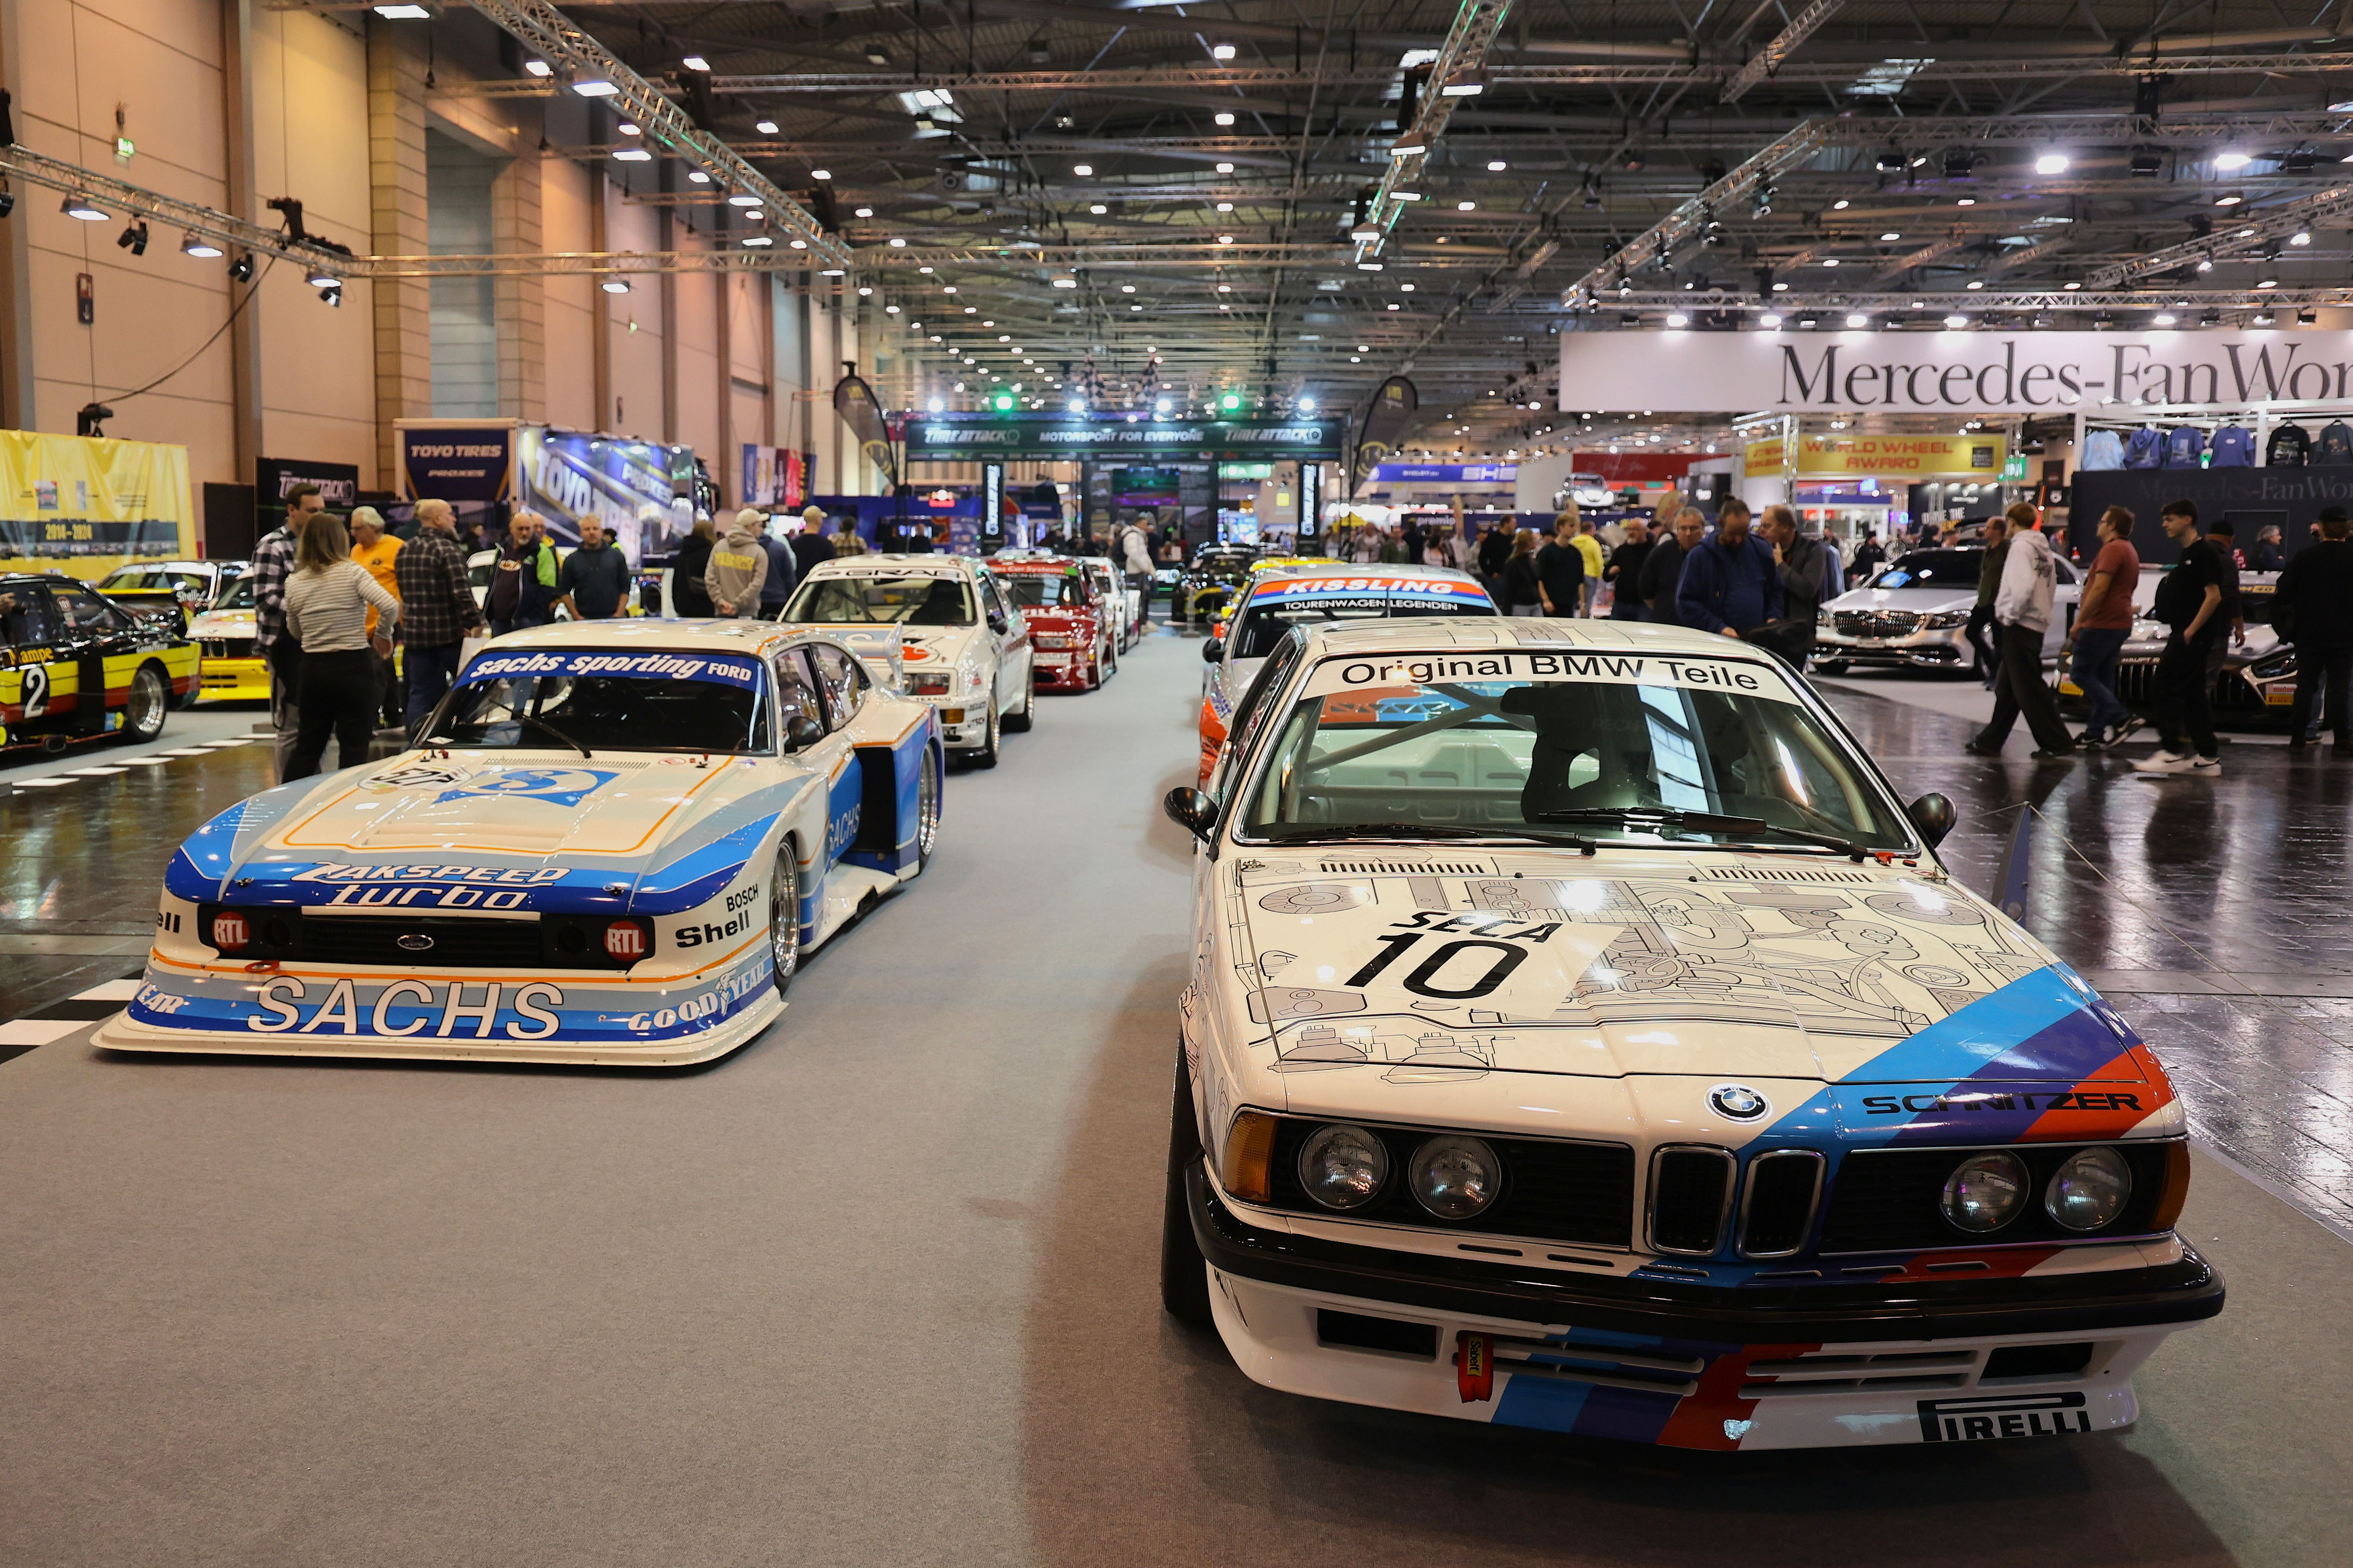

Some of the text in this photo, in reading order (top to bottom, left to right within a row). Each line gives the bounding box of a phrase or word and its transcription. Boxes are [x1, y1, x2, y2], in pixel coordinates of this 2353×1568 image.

[1039, 431, 1204, 442] MOTORSPORT FOR EVERYONE
[1882, 441, 1953, 454] WHEEL
[410, 445, 503, 458] TOYO TIRES
[535, 446, 591, 519] TOYO
[1416, 515, 1456, 527] premio
[1284, 580, 1454, 594] KISSLING
[1284, 598, 1458, 611] TOURENWAGEN LEGENDEN
[470, 653, 753, 682] sachs sporting FORD
[1342, 655, 1759, 690] Original BMW Teile
[24, 667, 46, 719] 2
[291, 861, 572, 887] ZAKSPEED
[334, 885, 528, 909] turbo
[726, 883, 759, 912] BOSCH
[214, 919, 249, 943] RTL
[675, 909, 750, 948] Shell
[1389, 911, 1564, 942] SECA
[607, 928, 645, 953] RTL
[1345, 933, 1529, 999] 10
[247, 975, 564, 1040] SACHS
[1862, 1091, 2144, 1115] SCHNITZER
[1917, 1391, 2092, 1443] PIRELLI
